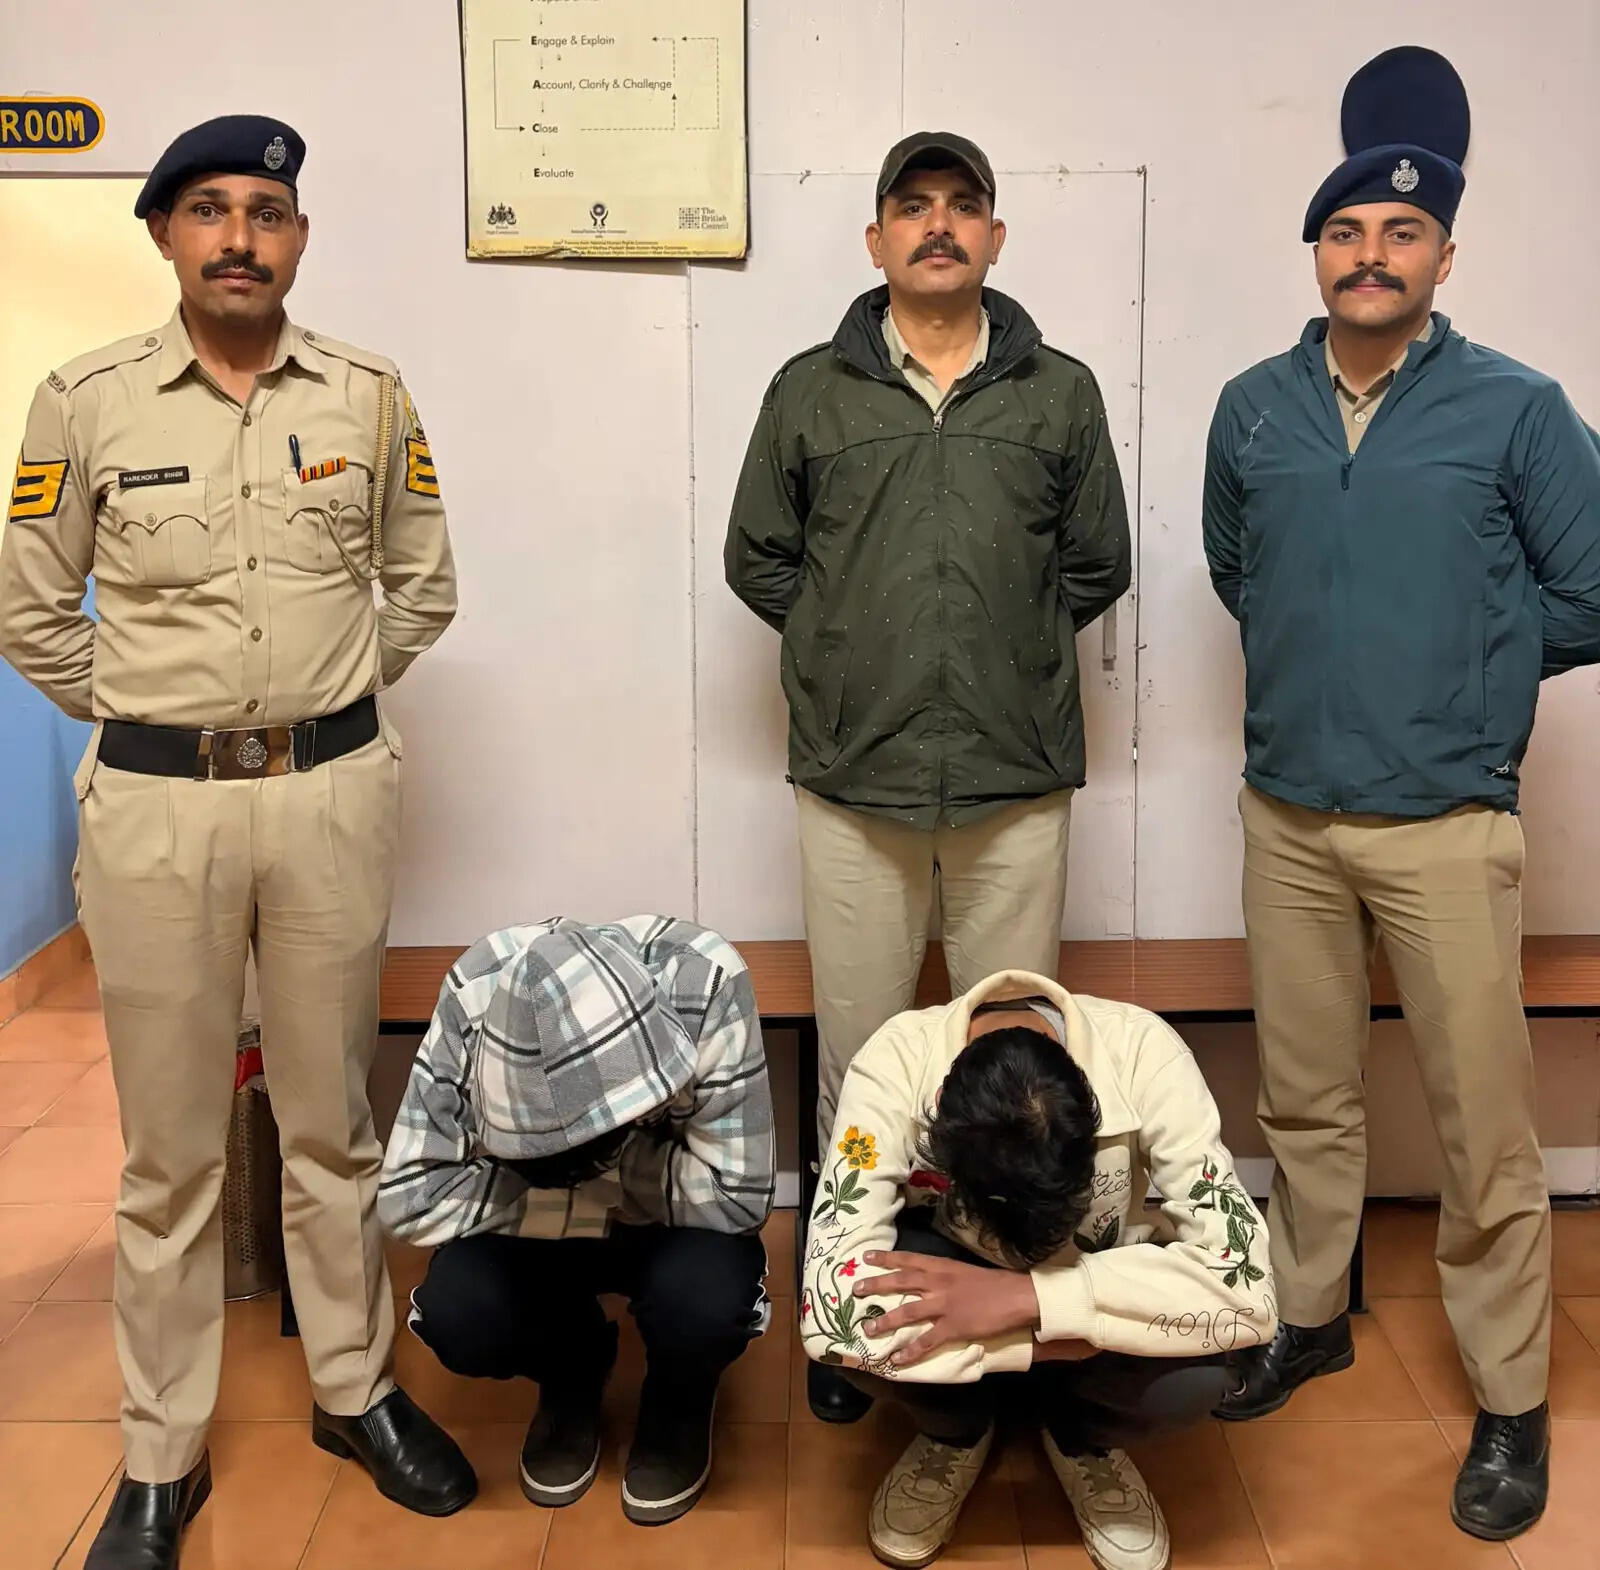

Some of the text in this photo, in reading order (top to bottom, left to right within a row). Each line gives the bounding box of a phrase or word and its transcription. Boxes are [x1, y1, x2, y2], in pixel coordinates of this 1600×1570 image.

[531, 34, 615, 48] Engage & Explain
[532, 78, 672, 91] Account, Clarify & Challenge
[1, 109, 86, 142] ROOM
[532, 123, 559, 133] Close
[533, 168, 575, 178] Evaluate
[1147, 1308, 1260, 1352] Dior
